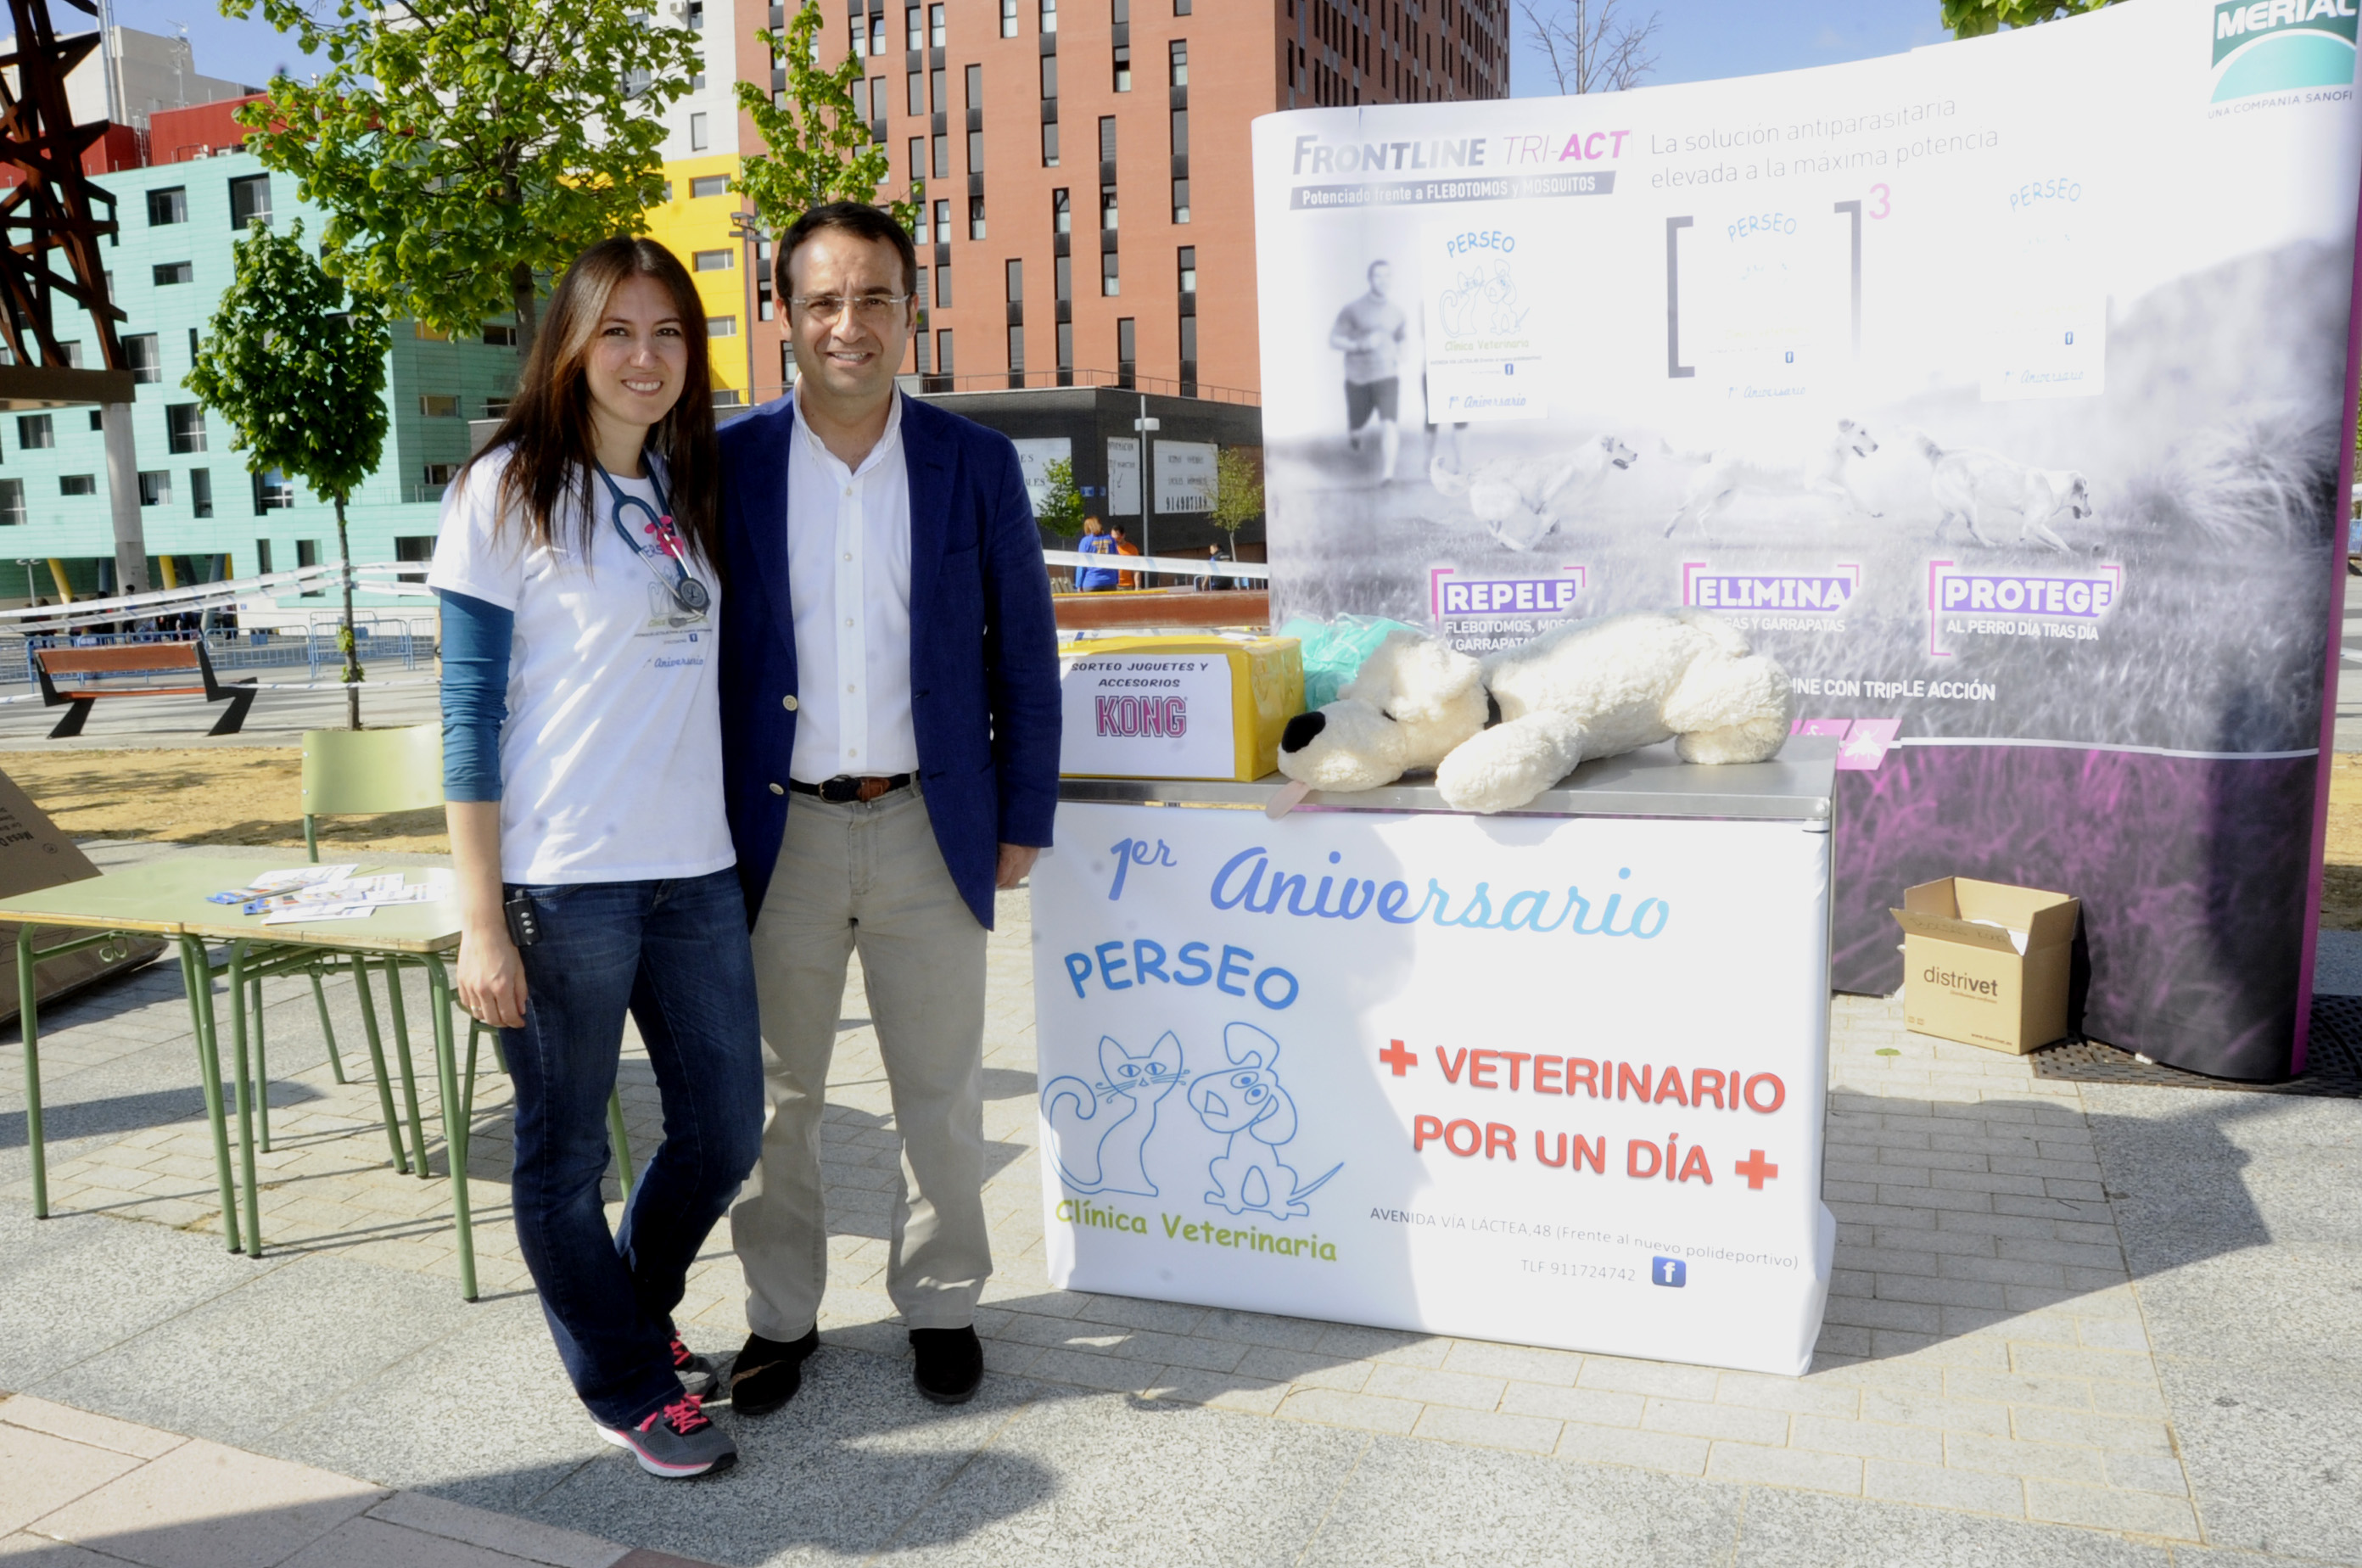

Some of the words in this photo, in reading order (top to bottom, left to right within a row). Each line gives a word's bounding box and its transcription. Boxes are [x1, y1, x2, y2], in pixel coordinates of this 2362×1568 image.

[2217, 0, 2356, 40] MERIAL
[2208, 107, 2230, 120] UNA
[2305, 90, 2353, 104] SANOFI
[1651, 134, 1677, 154] La
[1685, 122, 1779, 151] solución
[1786, 95, 1956, 141] antiparasitaria
[1292, 134, 1486, 176] FRONTLINE
[1503, 129, 1631, 165] TRI-ACT
[1651, 162, 1738, 188] elevada
[1745, 165, 1758, 180] a
[1766, 158, 1786, 178] la
[1794, 149, 1889, 175] máxima
[1896, 126, 1999, 169] potencia
[1302, 188, 1370, 205] Potenciado
[1374, 186, 1412, 202] frente
[1415, 189, 1424, 200] a
[1427, 181, 1508, 199] FLEBOTOMOS
[1512, 183, 1520, 198] y
[1523, 176, 1596, 194] MOSQUITOS
[1867, 182, 1892, 221] 3
[2010, 177, 2081, 212] PERSEO
[1727, 213, 1798, 242] PERSEO
[1447, 230, 1515, 258] PERSEO
[1464, 392, 1526, 408] Aniversario
[1447, 582, 1574, 611] REPELE
[1699, 579, 1848, 608] ELIMINA
[1945, 578, 2110, 614] PROTEGE
[1445, 619, 1535, 634] FLEBOTOMOS,
[1751, 618, 1759, 630] Y
[1761, 618, 1846, 632] GARRAPATAS
[1946, 619, 1965, 633] AL
[1967, 620, 2016, 635] PERRO
[2018, 619, 2041, 636] DÍA
[2043, 623, 2075, 639] TRAS
[2079, 622, 2100, 641] DÍA
[1071, 662, 1122, 671] SORTEO
[1127, 662, 1195, 671] JUGUETES
[1200, 663, 1208, 671] Y
[1098, 678, 1180, 687] ACCESORIOS
[1824, 680, 1860, 697] CON
[1863, 680, 1924, 699] TRIPLE
[1927, 678, 1995, 701] ACCIÓN
[1094, 695, 1187, 738] KONG
[1109, 837, 1177, 900] 1er
[1210, 846, 1670, 939] Aniversario
[1064, 938, 1299, 1011] PERSEO
[1923, 966, 1998, 997] distrivet
[1435, 1045, 1786, 1113] VETERINARIO
[1413, 1114, 1516, 1162] POR
[1535, 1129, 1606, 1174] UN
[1627, 1132, 1713, 1184] DÍA
[1055, 1199, 1147, 1235] Clínica
[1161, 1212, 1337, 1262] Veterinaria
[1370, 1207, 1436, 1227] AVENIDA
[1441, 1212, 1466, 1230] VÍA
[1556, 1224, 1612, 1245] (Frente
[1616, 1233, 1630, 1246] al
[1634, 1240, 1682, 1255] nuevo
[1686, 1244, 1799, 1270] polideportivo)
[1521, 1258, 1545, 1273] TLF
[1551, 1261, 1636, 1282] 911724742
